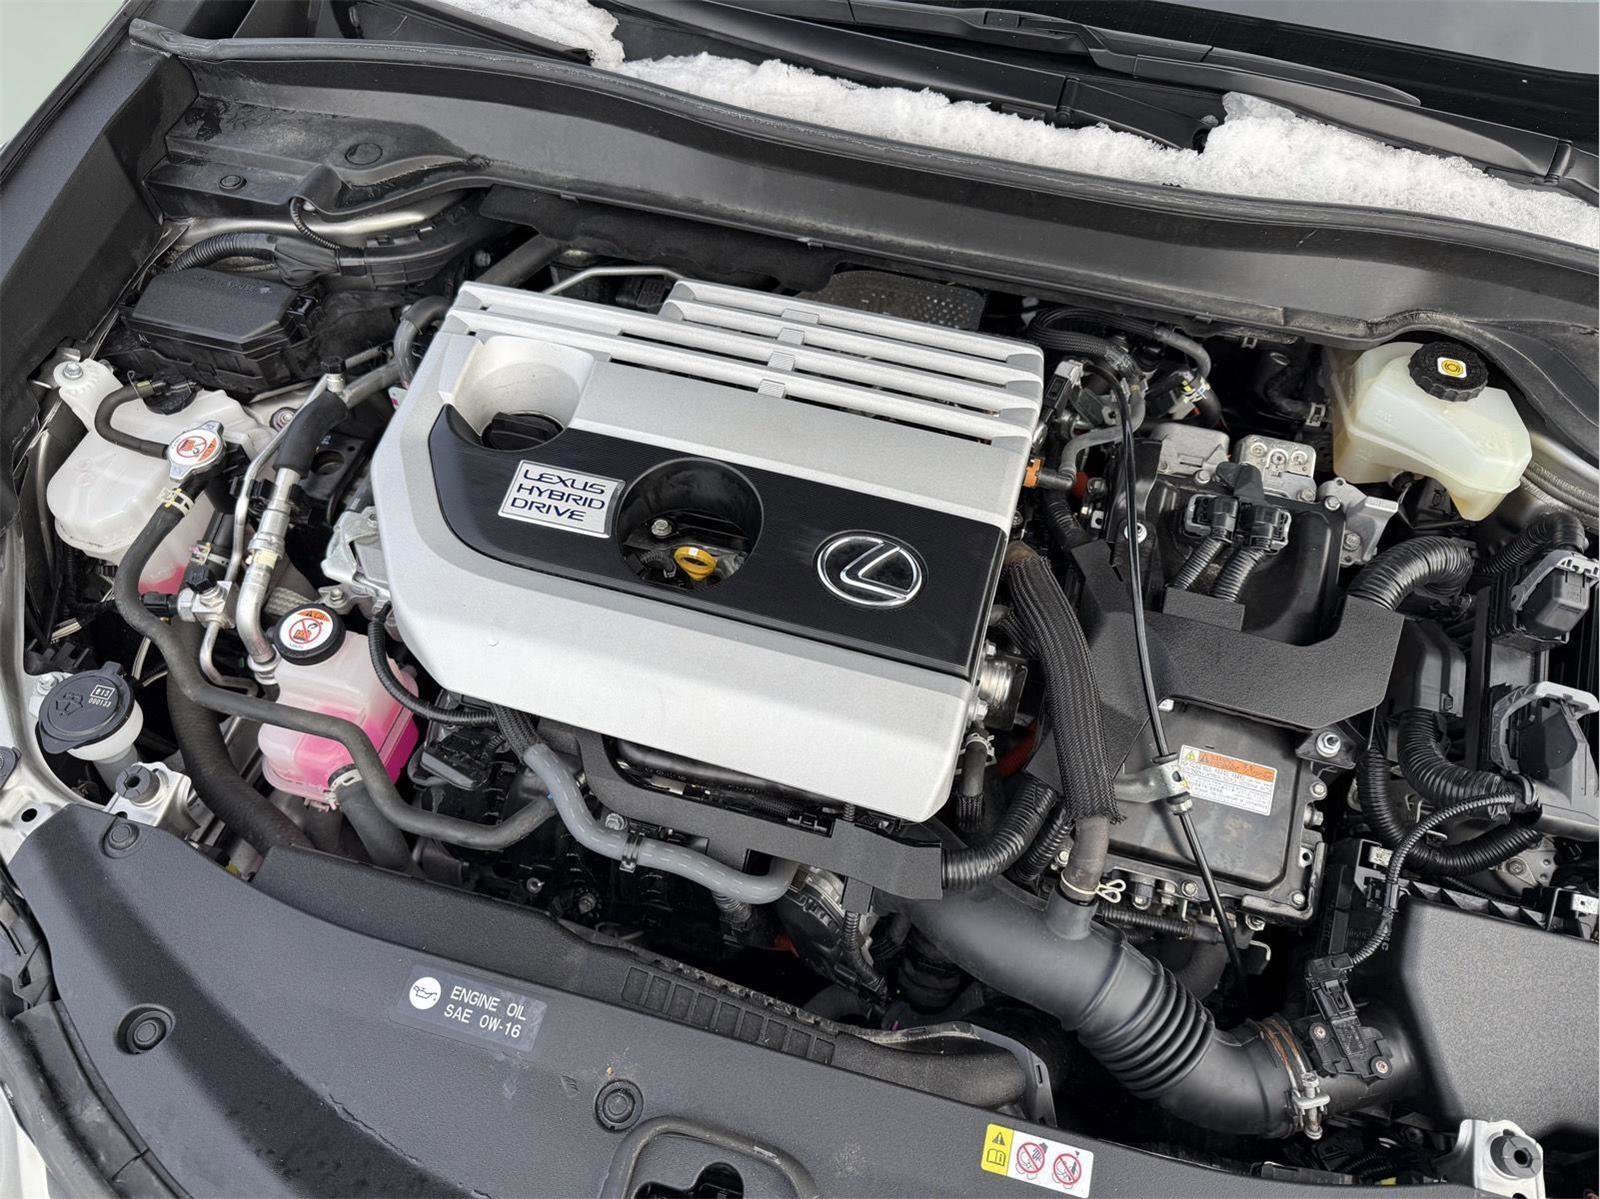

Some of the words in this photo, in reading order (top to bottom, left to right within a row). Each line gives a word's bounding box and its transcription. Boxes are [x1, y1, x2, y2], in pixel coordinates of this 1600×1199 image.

[523, 469, 606, 494] LEXUS
[511, 497, 587, 522] DRIVE
[516, 483, 606, 510] HYBRID
[450, 985, 501, 1012] ENGINE
[506, 1003, 527, 1021] OIL
[444, 1004, 474, 1023] SAE
[479, 1015, 521, 1038] 0W-16
